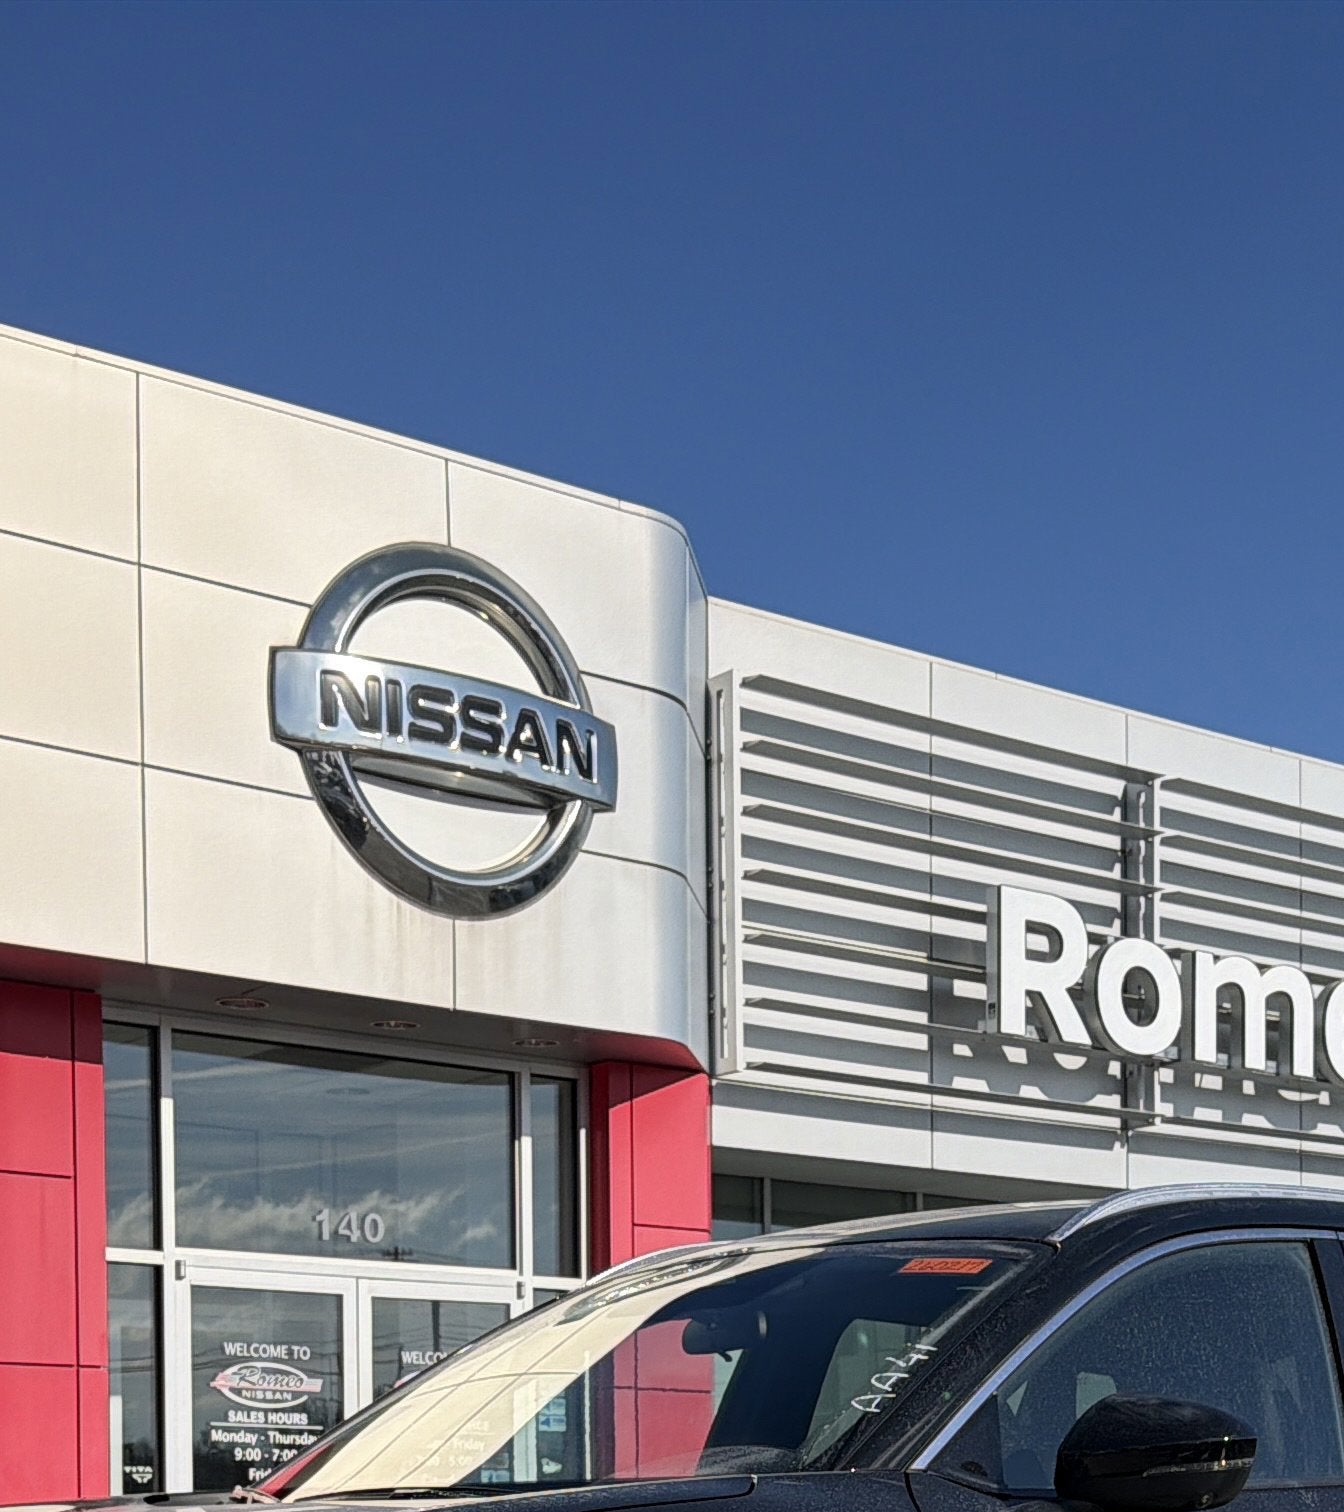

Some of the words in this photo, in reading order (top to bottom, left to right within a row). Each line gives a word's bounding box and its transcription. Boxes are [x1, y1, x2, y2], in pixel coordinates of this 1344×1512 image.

[316, 669, 598, 784] NISSAN
[315, 1207, 385, 1244] 140
[223, 1341, 289, 1360] WELCOME
[291, 1345, 311, 1361] TO
[400, 1350, 448, 1365] WELCO
[231, 1365, 305, 1389] Romeo
[241, 1389, 293, 1401] NISSAN
[228, 1410, 265, 1424] SALES
[267, 1411, 308, 1425] HOURS
[210, 1429, 258, 1446] Monday
[267, 1430, 320, 1446] Thursda
[234, 1447, 262, 1462] 9:00
